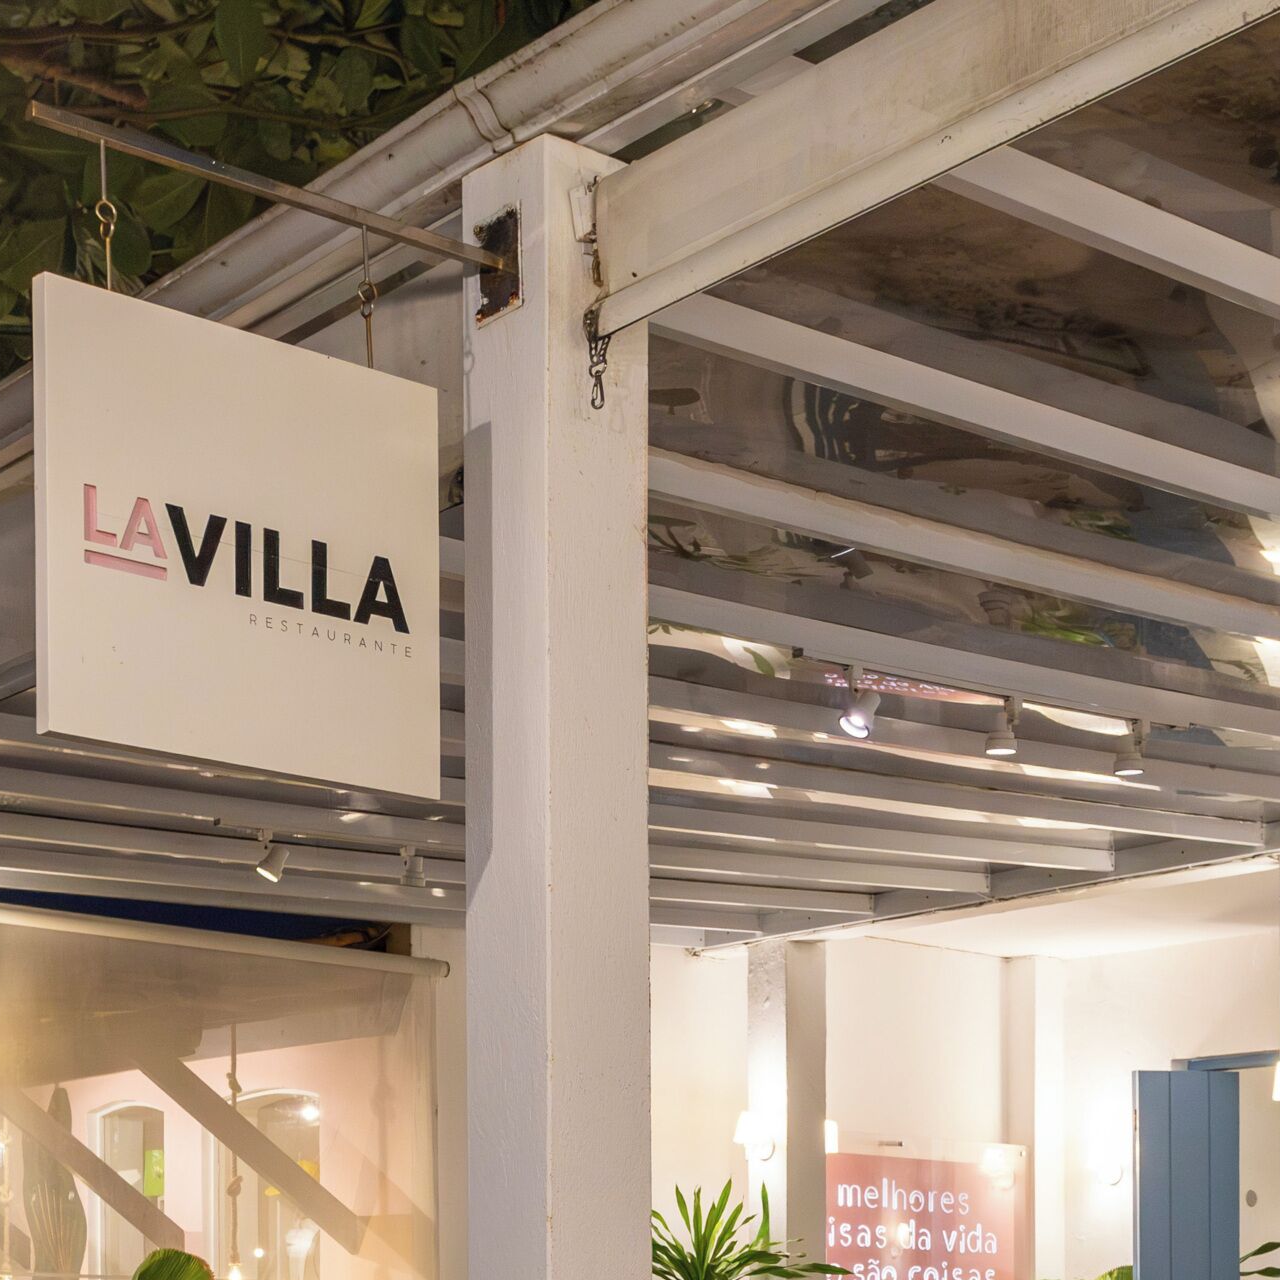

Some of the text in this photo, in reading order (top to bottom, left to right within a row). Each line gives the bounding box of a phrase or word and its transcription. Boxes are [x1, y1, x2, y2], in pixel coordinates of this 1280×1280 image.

[249, 613, 413, 658] RESTAURANTE
[837, 1177, 969, 1215] melhores
[828, 1216, 998, 1255] isas da vida
